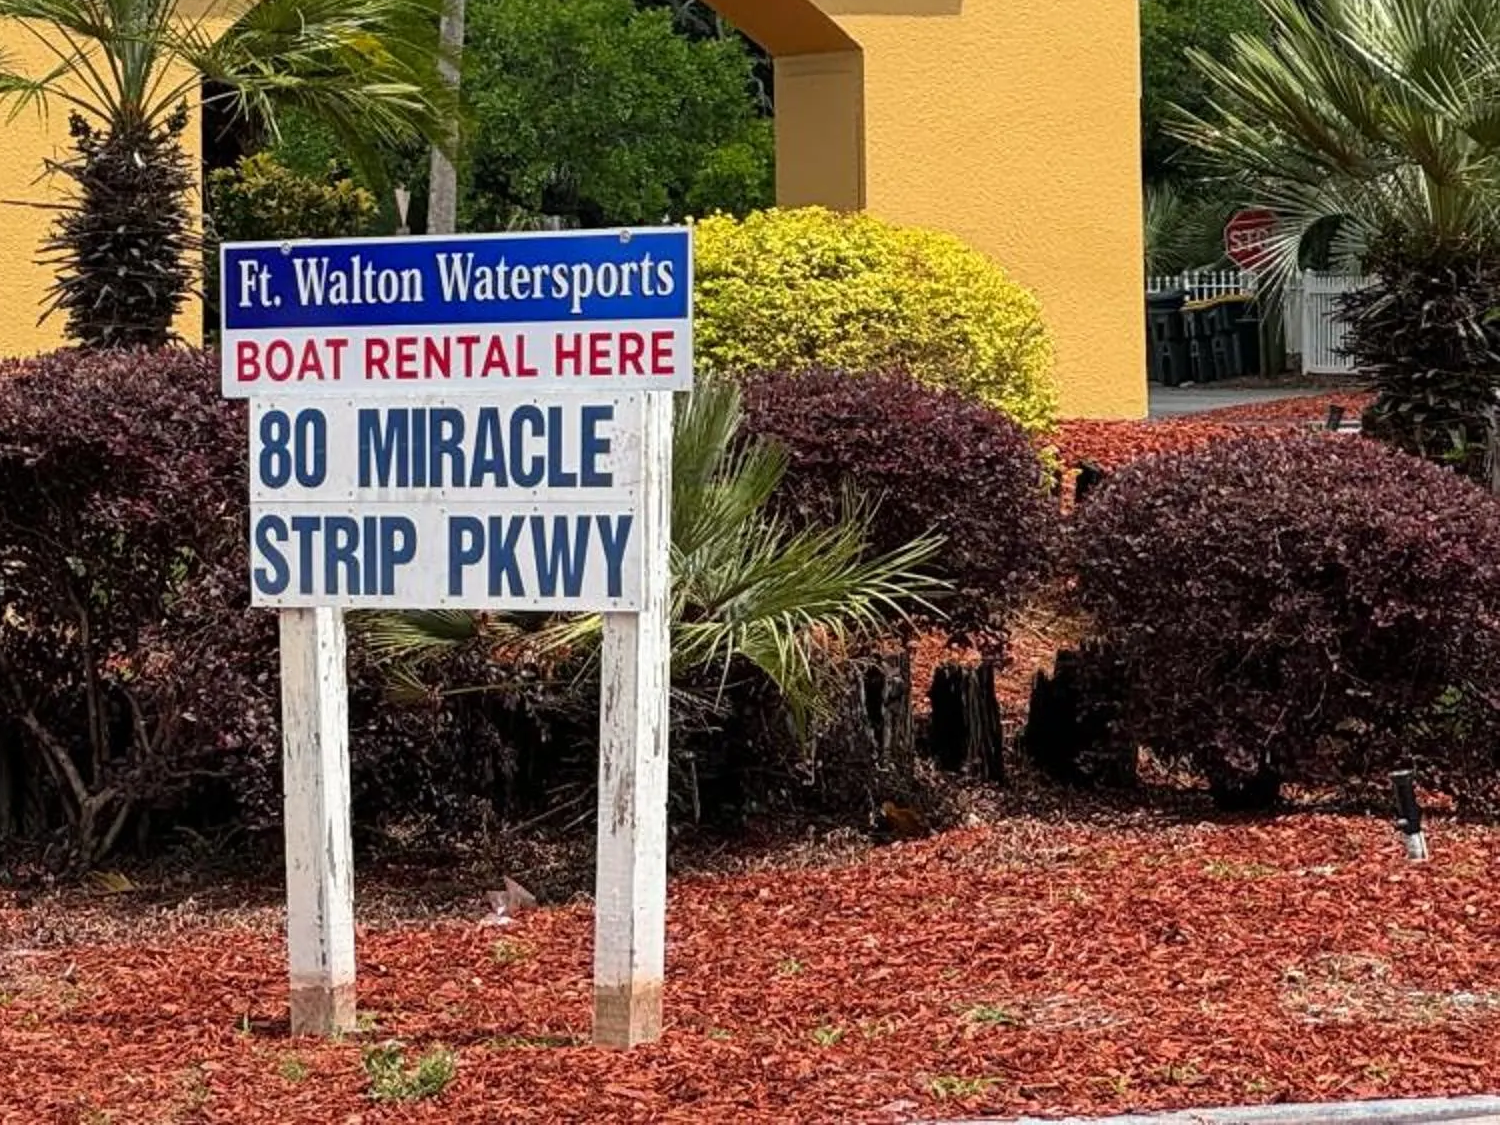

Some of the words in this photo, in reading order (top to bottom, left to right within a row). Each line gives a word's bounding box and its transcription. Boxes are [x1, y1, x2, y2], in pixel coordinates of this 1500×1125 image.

[1229, 228, 1273, 252] STO
[238, 259, 282, 308] Ft.
[293, 254, 424, 306] Walton
[436, 250, 675, 314] Watersports
[236, 338, 349, 383] BOAT
[365, 333, 538, 380] RENTAL
[554, 330, 675, 376] HERE
[258, 407, 328, 490] 80
[357, 404, 615, 489] MIRACLE
[253, 513, 418, 597] STRIP
[447, 514, 634, 598] PKWY
